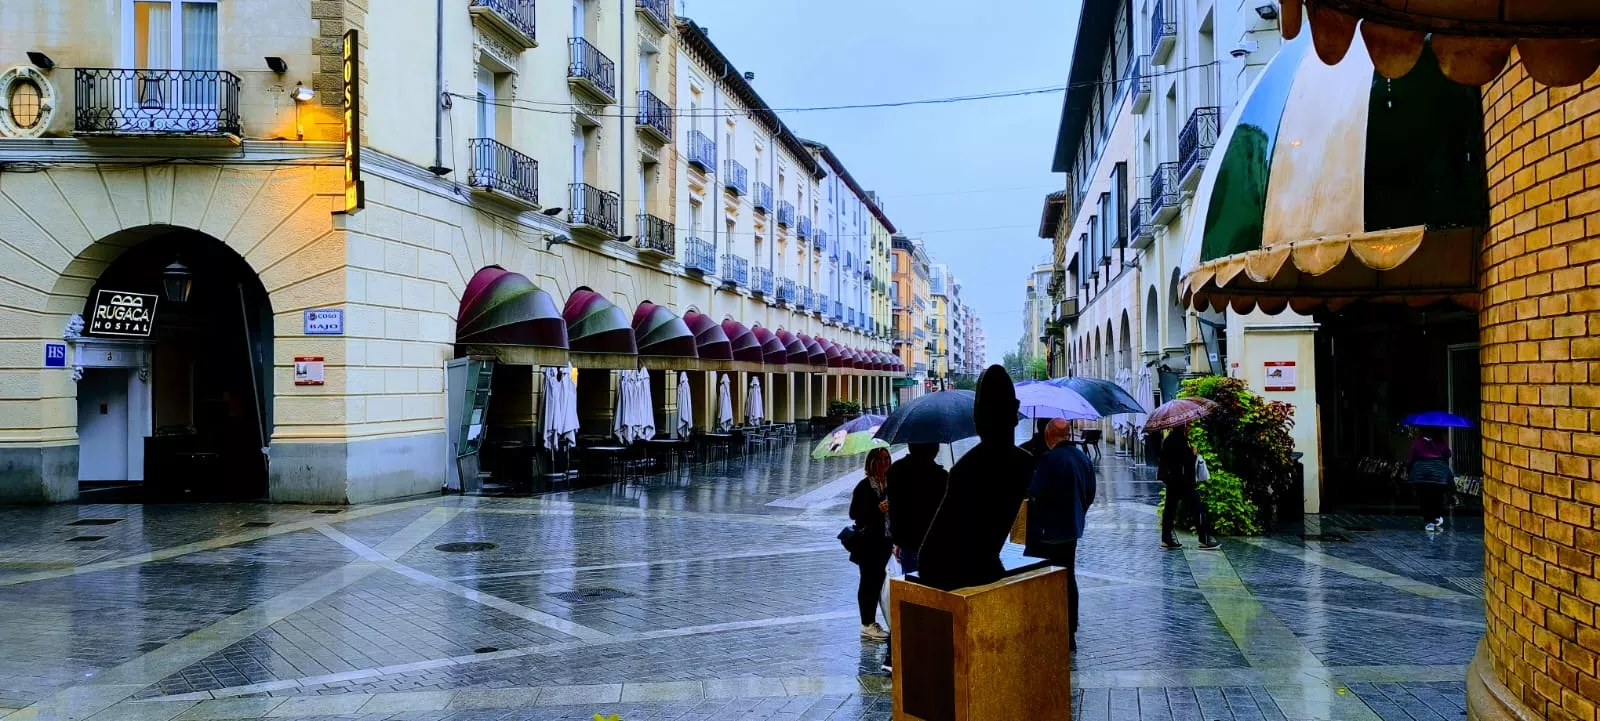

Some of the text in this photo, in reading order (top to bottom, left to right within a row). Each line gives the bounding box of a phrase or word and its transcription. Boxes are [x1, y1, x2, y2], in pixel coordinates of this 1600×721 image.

[344, 37, 352, 182] HOSTAL
[96, 305, 149, 322] RUGACA
[94, 321, 148, 332] HOSTAL
[47, 345, 64, 358] HS
